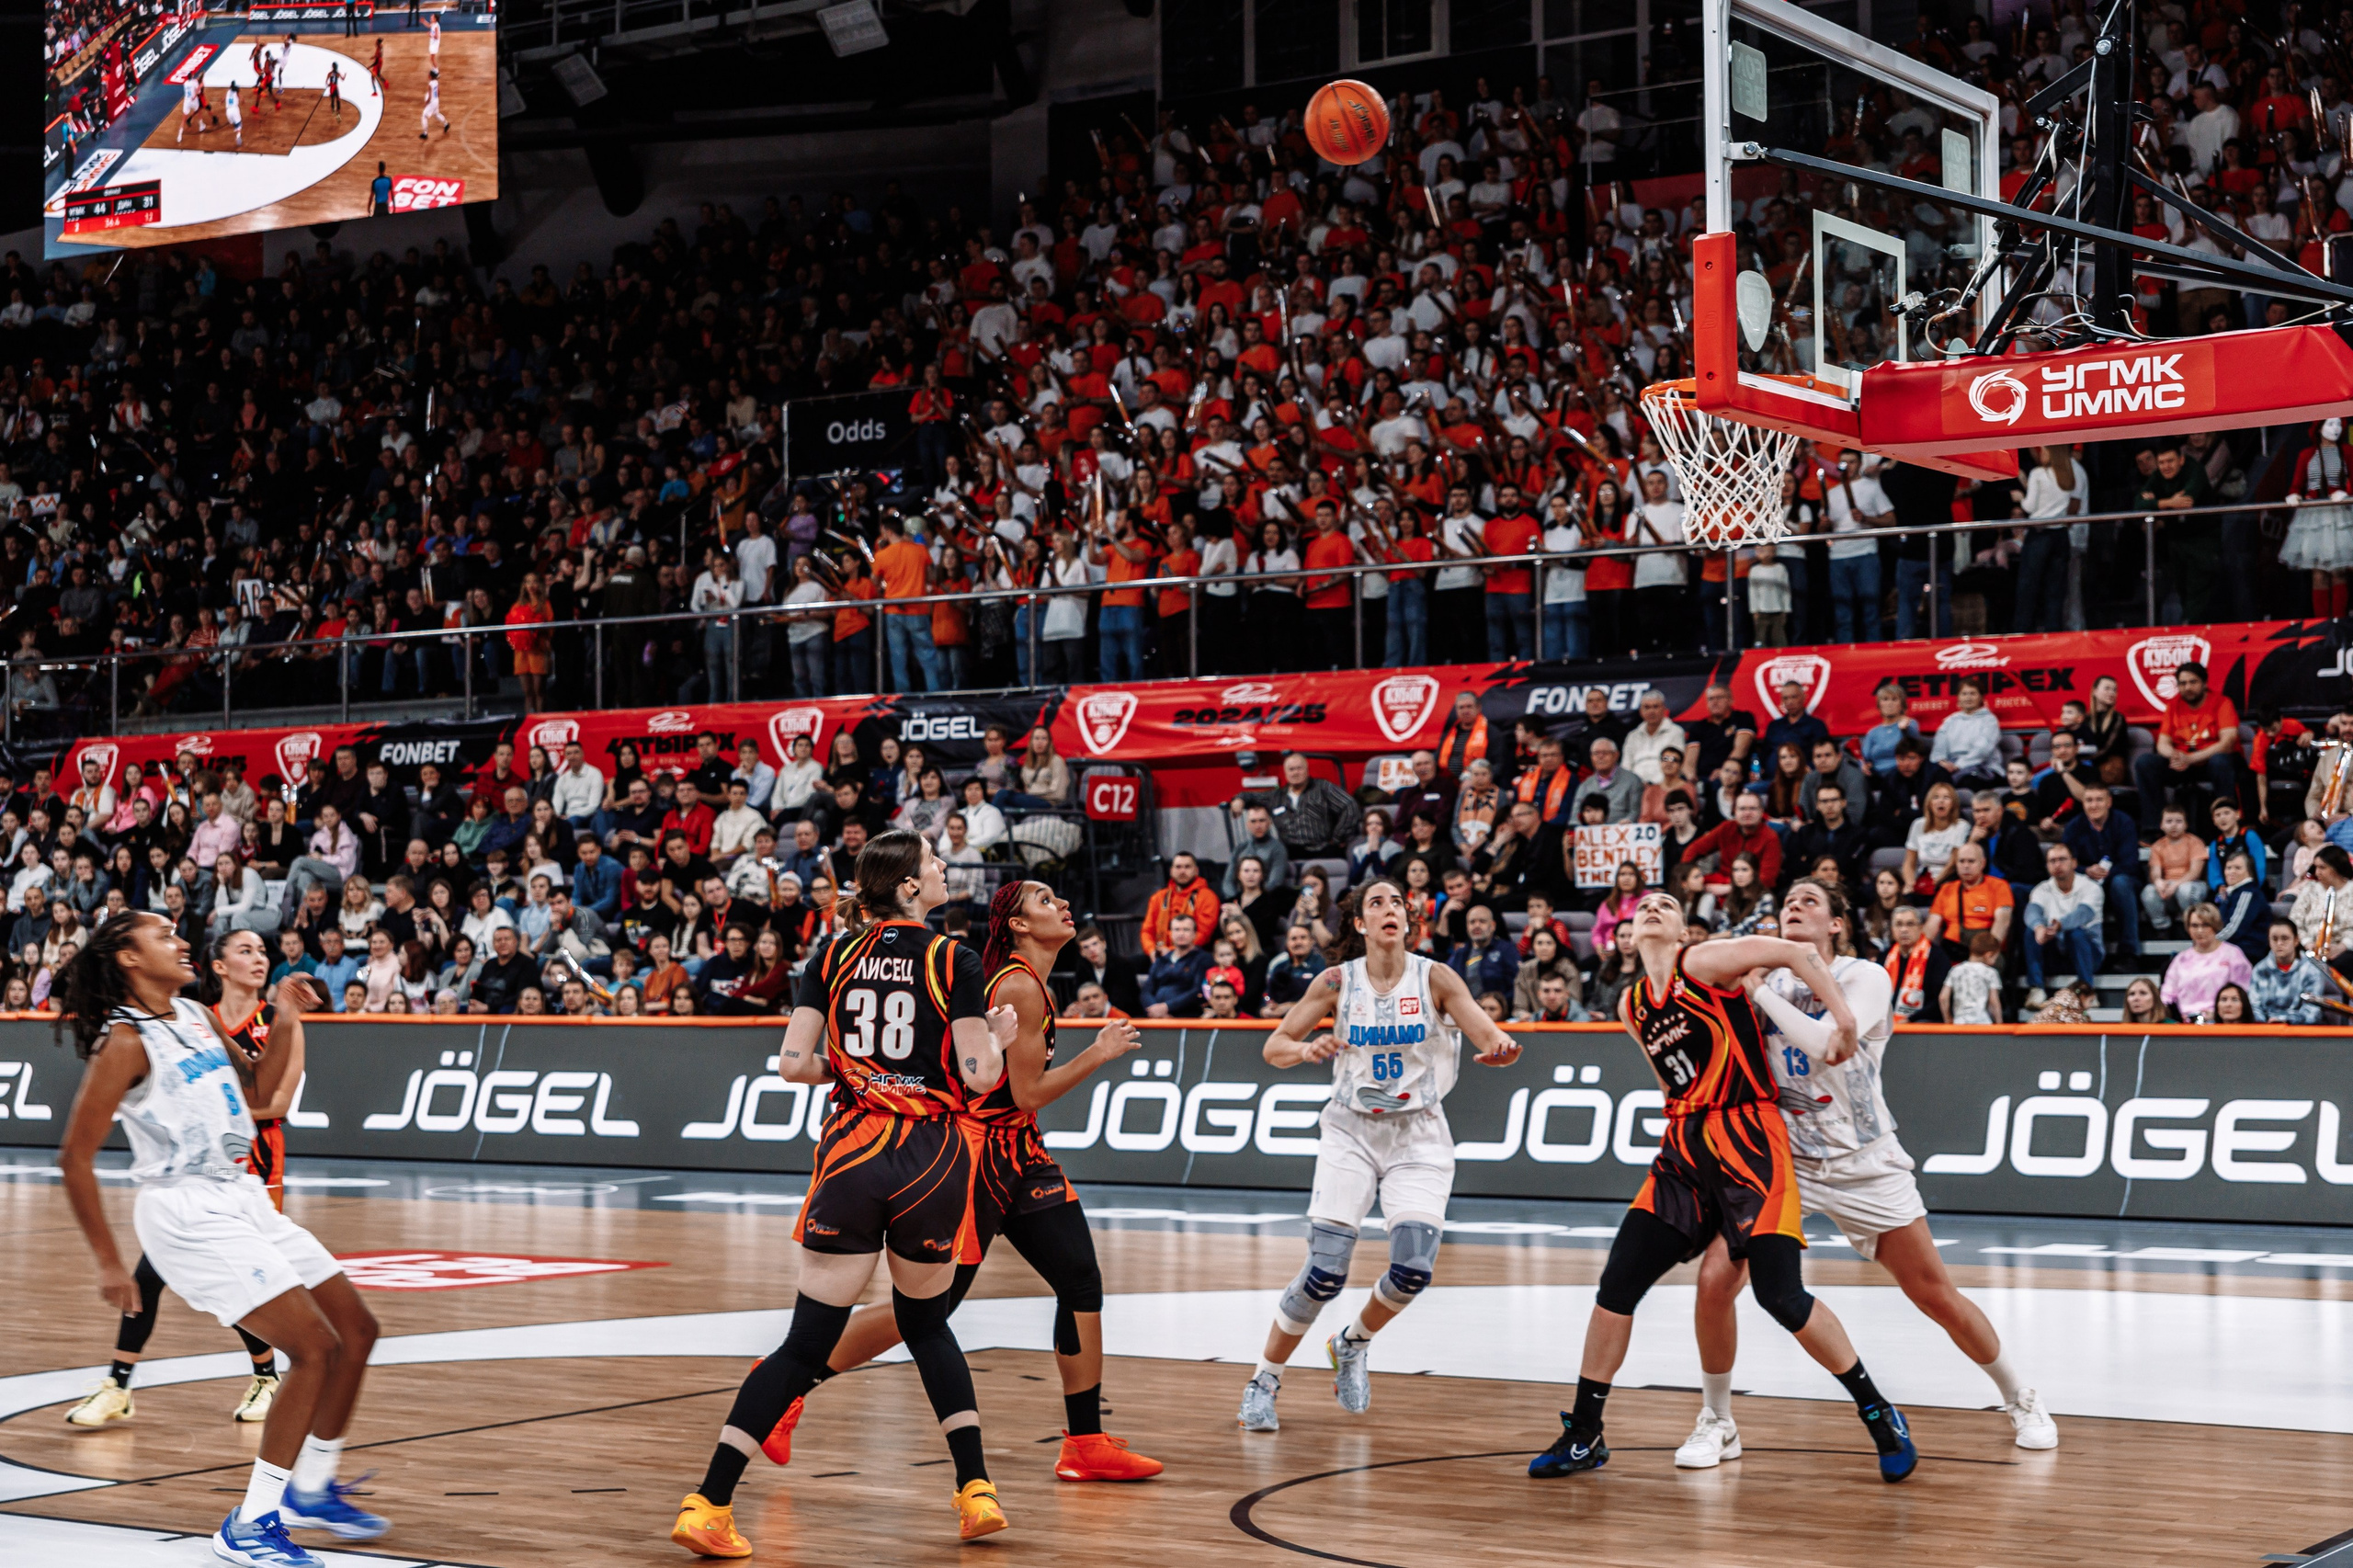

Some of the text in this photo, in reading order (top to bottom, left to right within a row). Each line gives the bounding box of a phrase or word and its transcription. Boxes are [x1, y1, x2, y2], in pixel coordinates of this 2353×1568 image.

[142, 196, 153, 208] 31
[392, 192, 458, 210] BET
[395, 178, 460, 197] FON
[94, 202, 107, 215] 44
[2041, 353, 2184, 392] УГМК
[2042, 382, 2185, 419] UMMC
[826, 417, 887, 445] Odds
[1525, 682, 1651, 715] FONET
[899, 712, 985, 742] JÖGEL
[1172, 703, 1326, 728] 2024/25
[380, 740, 460, 765] FONBET
[1093, 783, 1135, 813] C12
[1575, 825, 1656, 846] ALEX 20
[1579, 870, 1612, 883] THE
[853, 957, 914, 985] ЛИСЕЦ
[845, 988, 915, 1060] 38
[1347, 1024, 1426, 1047] ДИНАМО
[1646, 1019, 1692, 1056] УГМК
[1372, 1052, 1404, 1081] 55
[1665, 1049, 1697, 1085] 31
[1782, 1046, 1810, 1076] 13
[362, 1050, 641, 1137] JÖGEL
[870, 1072, 925, 1087] УГМК
[1042, 1059, 1332, 1156] JÖGE
[1454, 1064, 1669, 1165] JÖG
